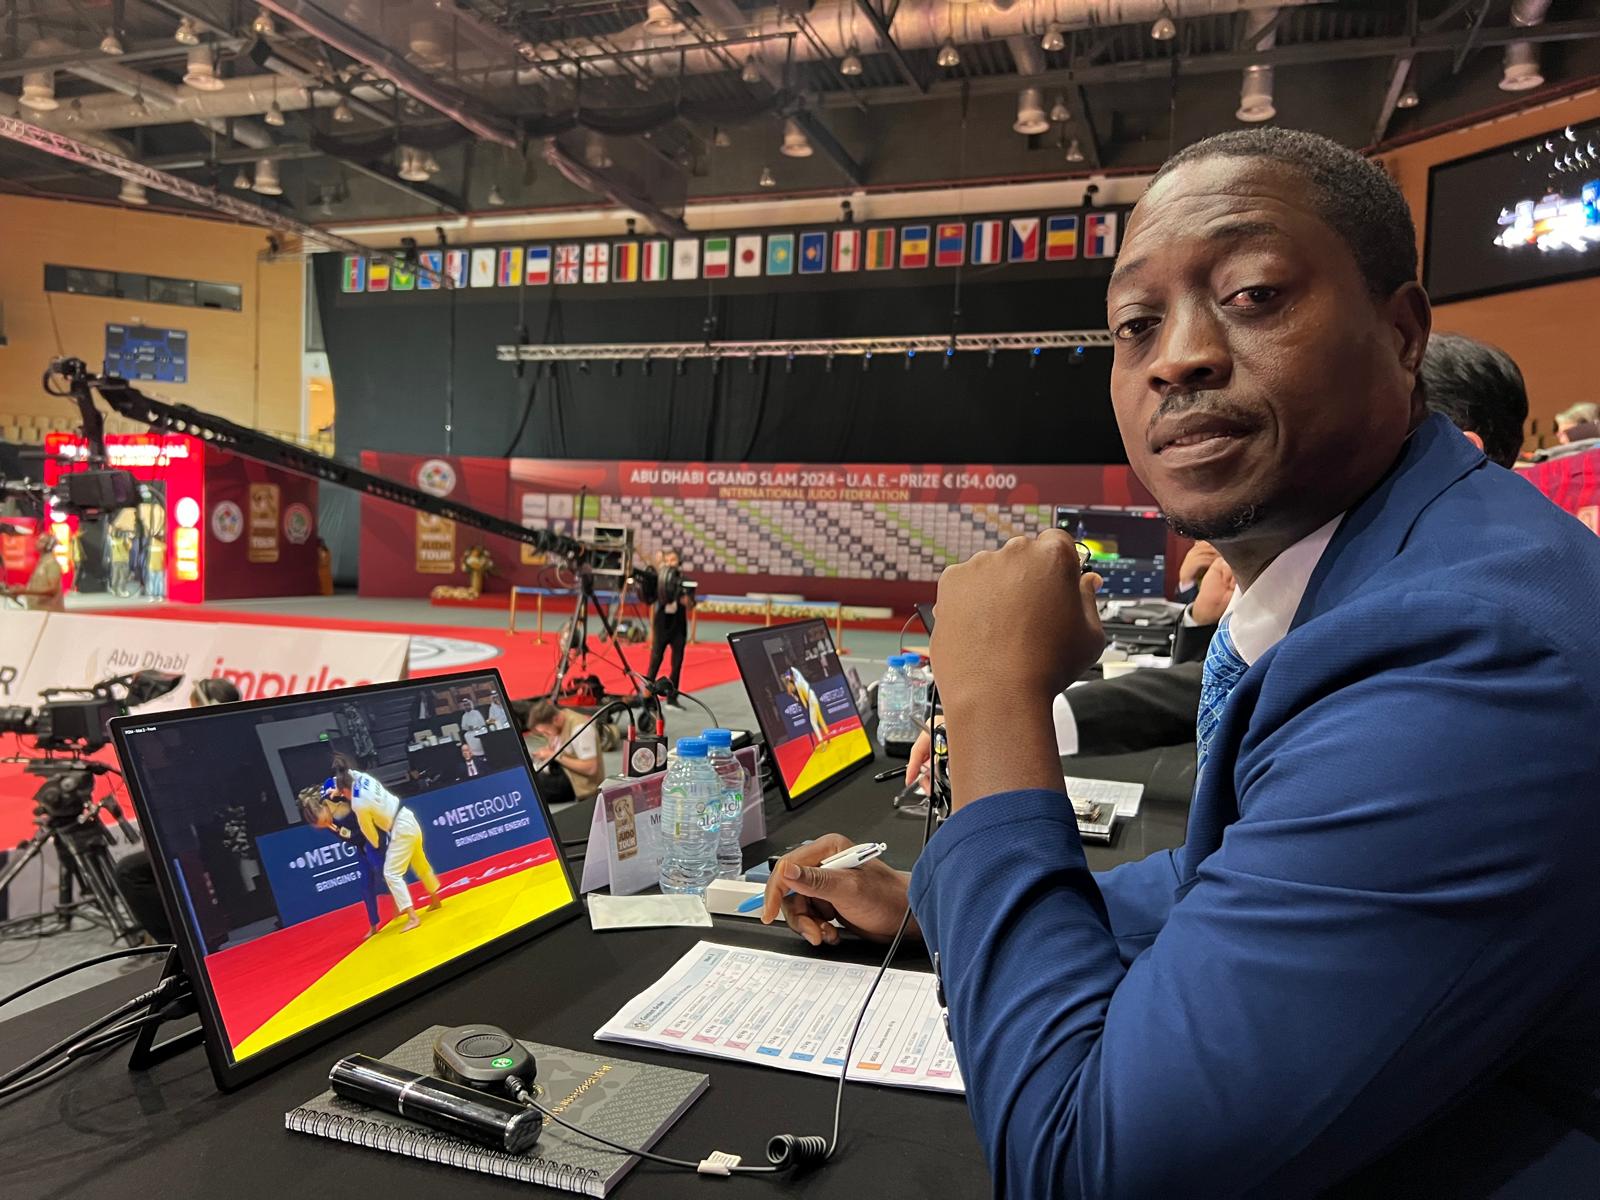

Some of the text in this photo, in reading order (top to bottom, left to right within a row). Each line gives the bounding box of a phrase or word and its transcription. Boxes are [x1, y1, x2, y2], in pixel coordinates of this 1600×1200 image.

[630, 469, 659, 484] ABU
[661, 469, 704, 485] DHABI
[706, 470, 755, 486] GRAND
[759, 471, 798, 487] SLAM
[800, 472, 835, 487] 2024
[846, 472, 889, 488] U.A.E.
[900, 473, 941, 489] PRIZE
[719, 487, 909, 501] INTERNATIONAL JUDO FEDERATION
[107, 649, 190, 672] Abu Dhabi
[211, 657, 374, 701] impul
[445, 790, 522, 827] METGROUP
[455, 830, 488, 847] BRINGING
[304, 841, 358, 869] METG
[315, 871, 357, 892] BRINGING
